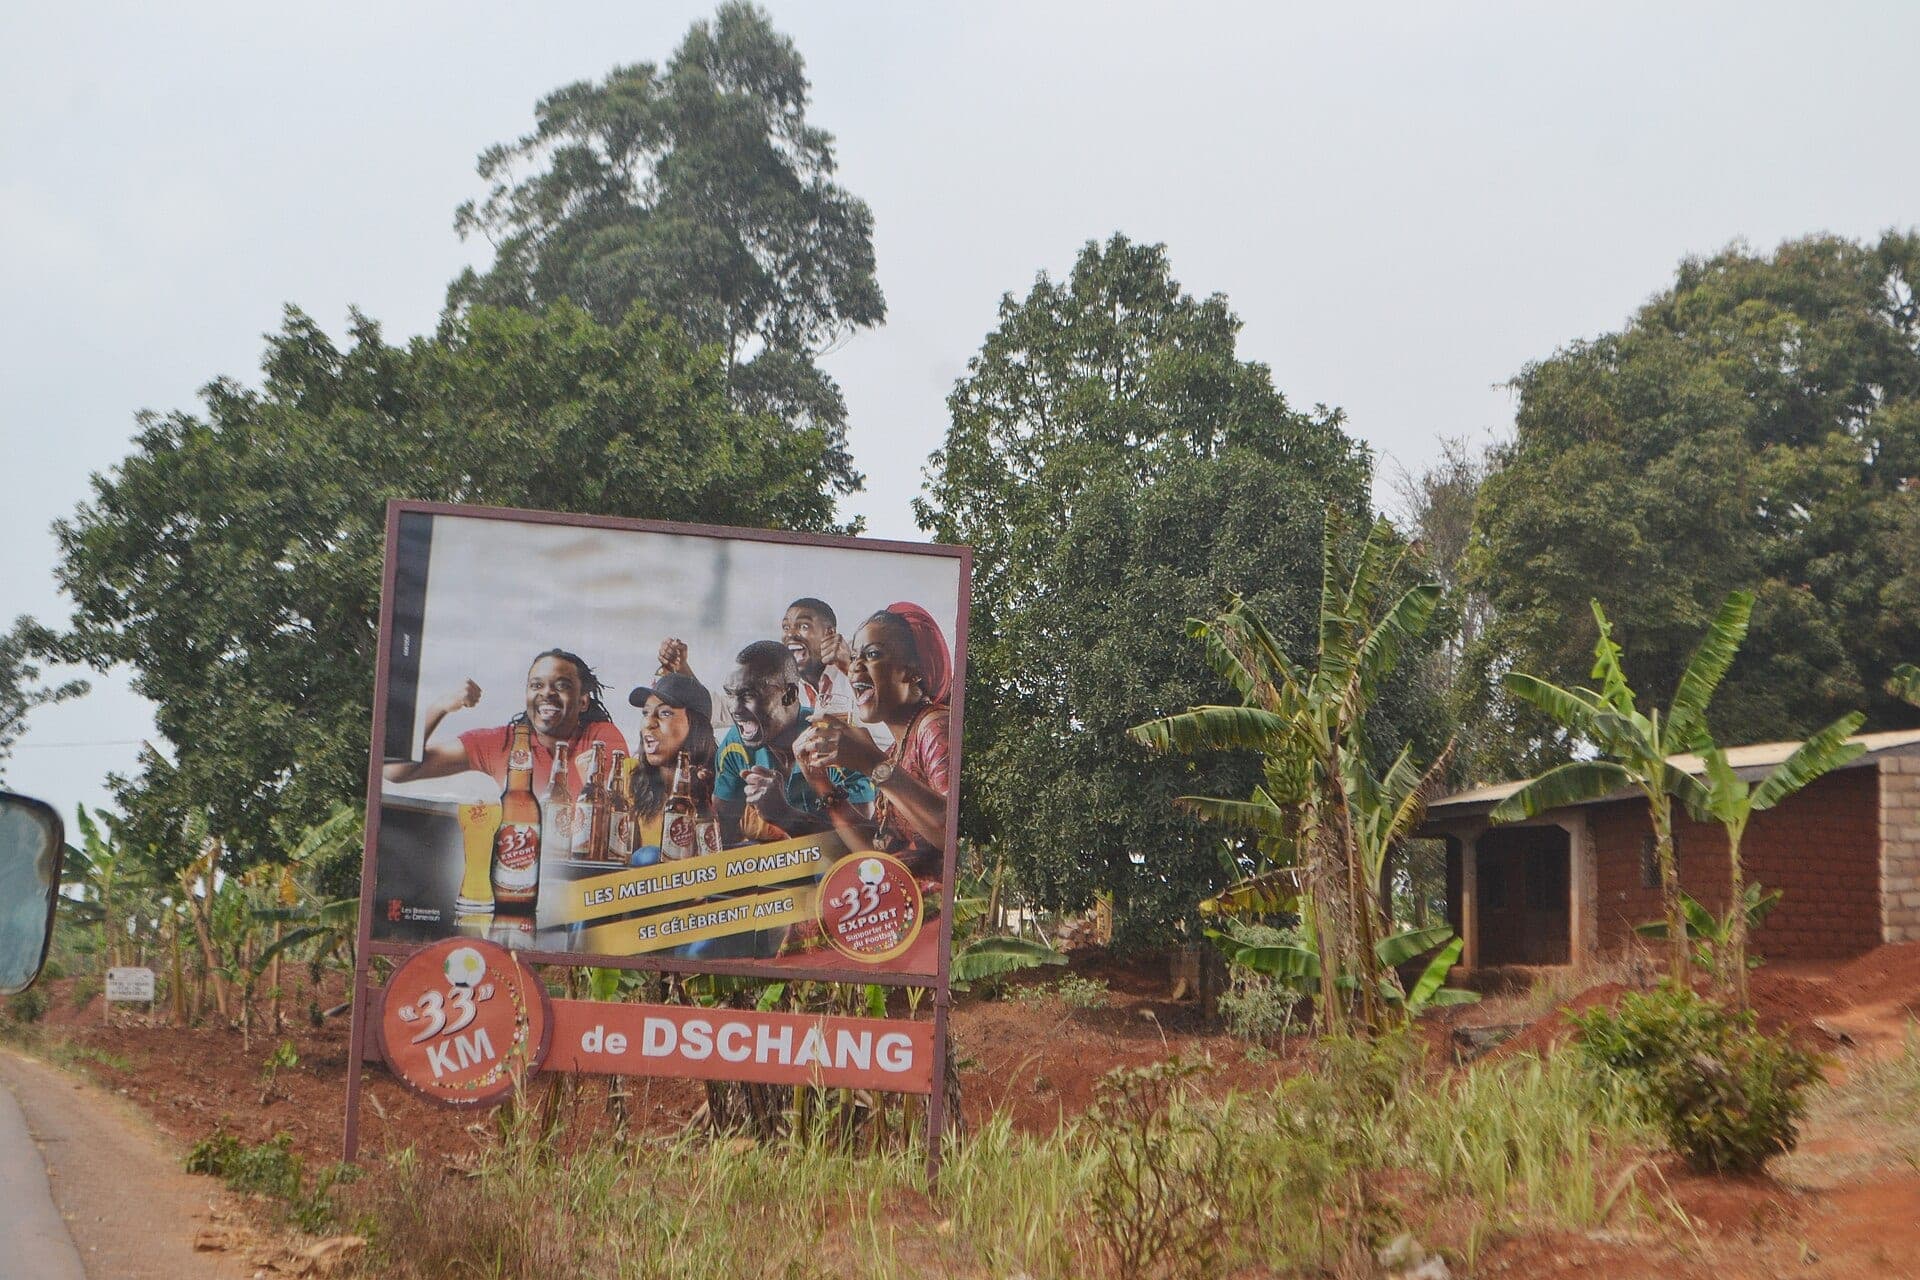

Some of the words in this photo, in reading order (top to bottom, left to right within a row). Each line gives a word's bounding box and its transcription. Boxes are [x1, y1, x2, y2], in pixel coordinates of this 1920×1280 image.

[501, 846, 536, 860] EXPORT
[584, 887, 614, 907] LES
[618, 866, 717, 900] MEILLEURS
[726, 846, 822, 877] MOMENTS
[638, 925, 657, 940] SE
[660, 905, 750, 935] CÉLÈBRENT
[754, 898, 794, 918] AVEC
[837, 907, 898, 934] EXPORT
[845, 926, 882, 942] Supporter
[853, 940, 864, 949] du
[865, 930, 896, 944] Football
[425, 1026, 496, 1079] KM
[581, 1025, 627, 1055] de
[641, 1017, 914, 1073] DSCHANG
